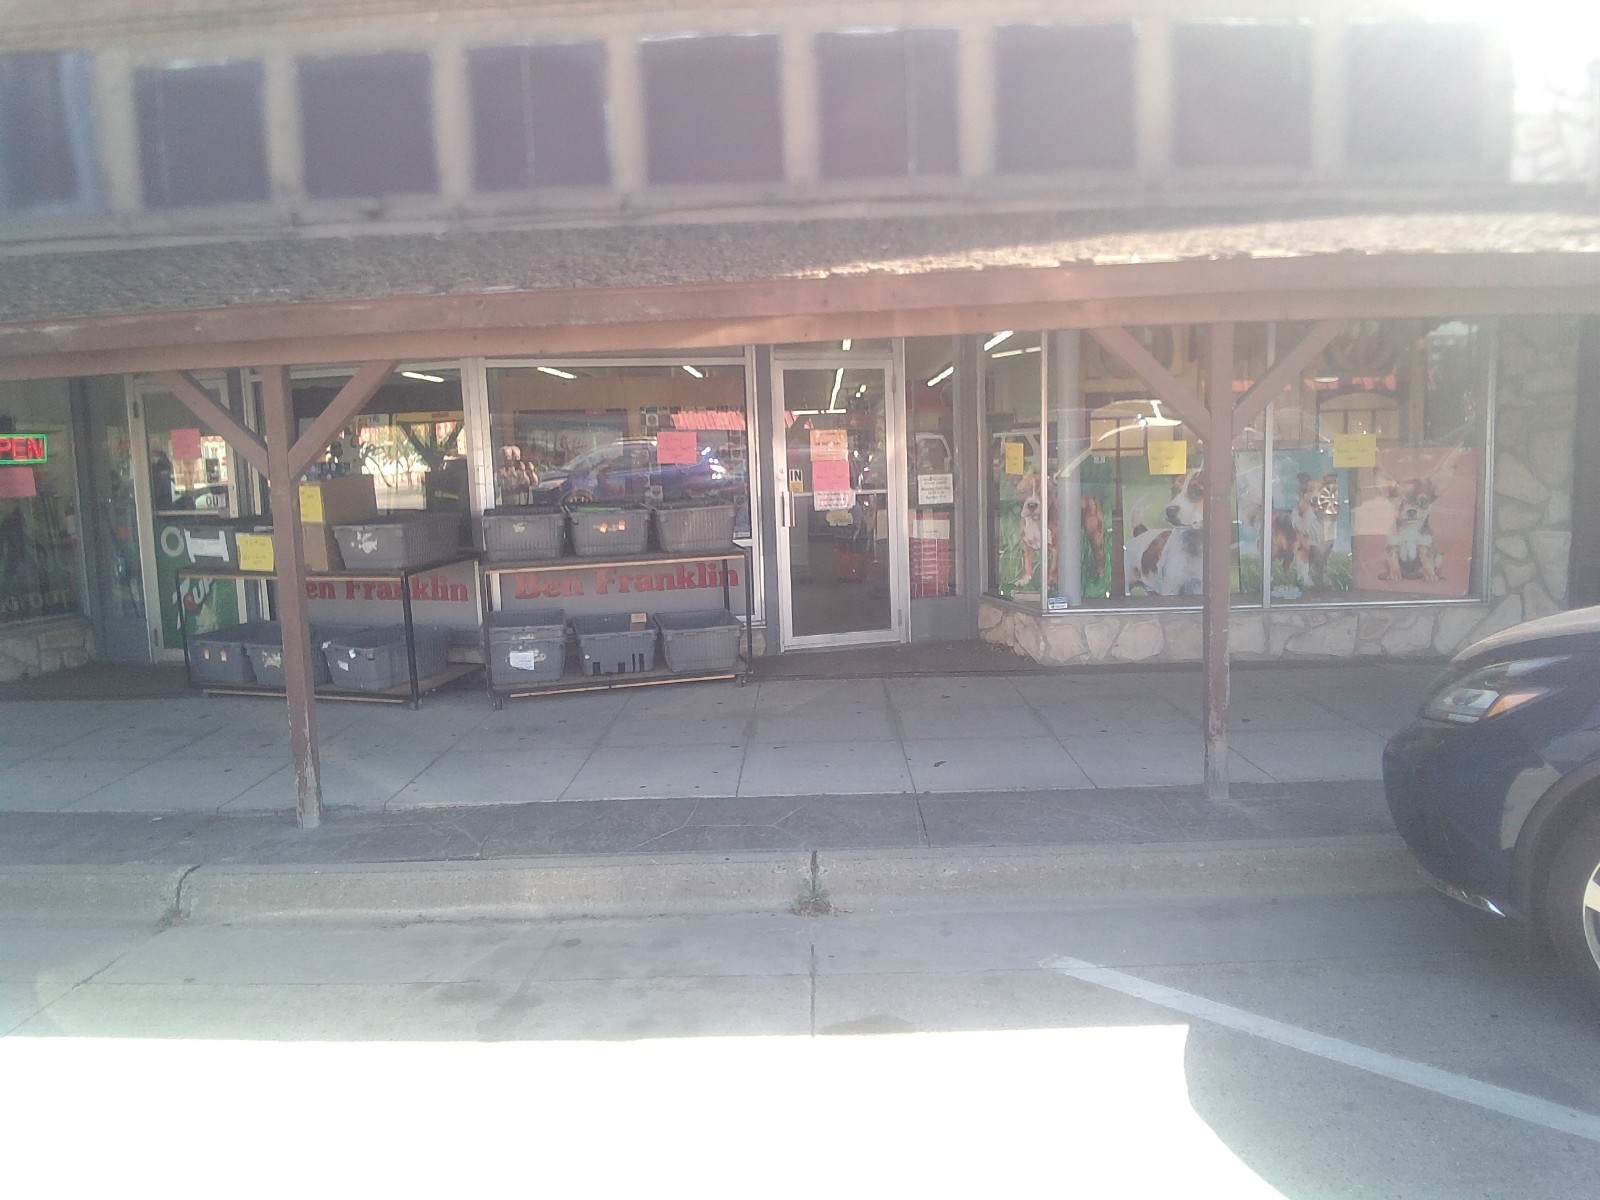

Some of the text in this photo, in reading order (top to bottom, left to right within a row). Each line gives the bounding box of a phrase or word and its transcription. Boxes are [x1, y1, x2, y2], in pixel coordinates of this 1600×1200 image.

[0, 438, 43, 459] PEN
[790, 470, 802, 482] IN
[305, 580, 336, 600] en
[515, 563, 739, 600] Ben Franklin
